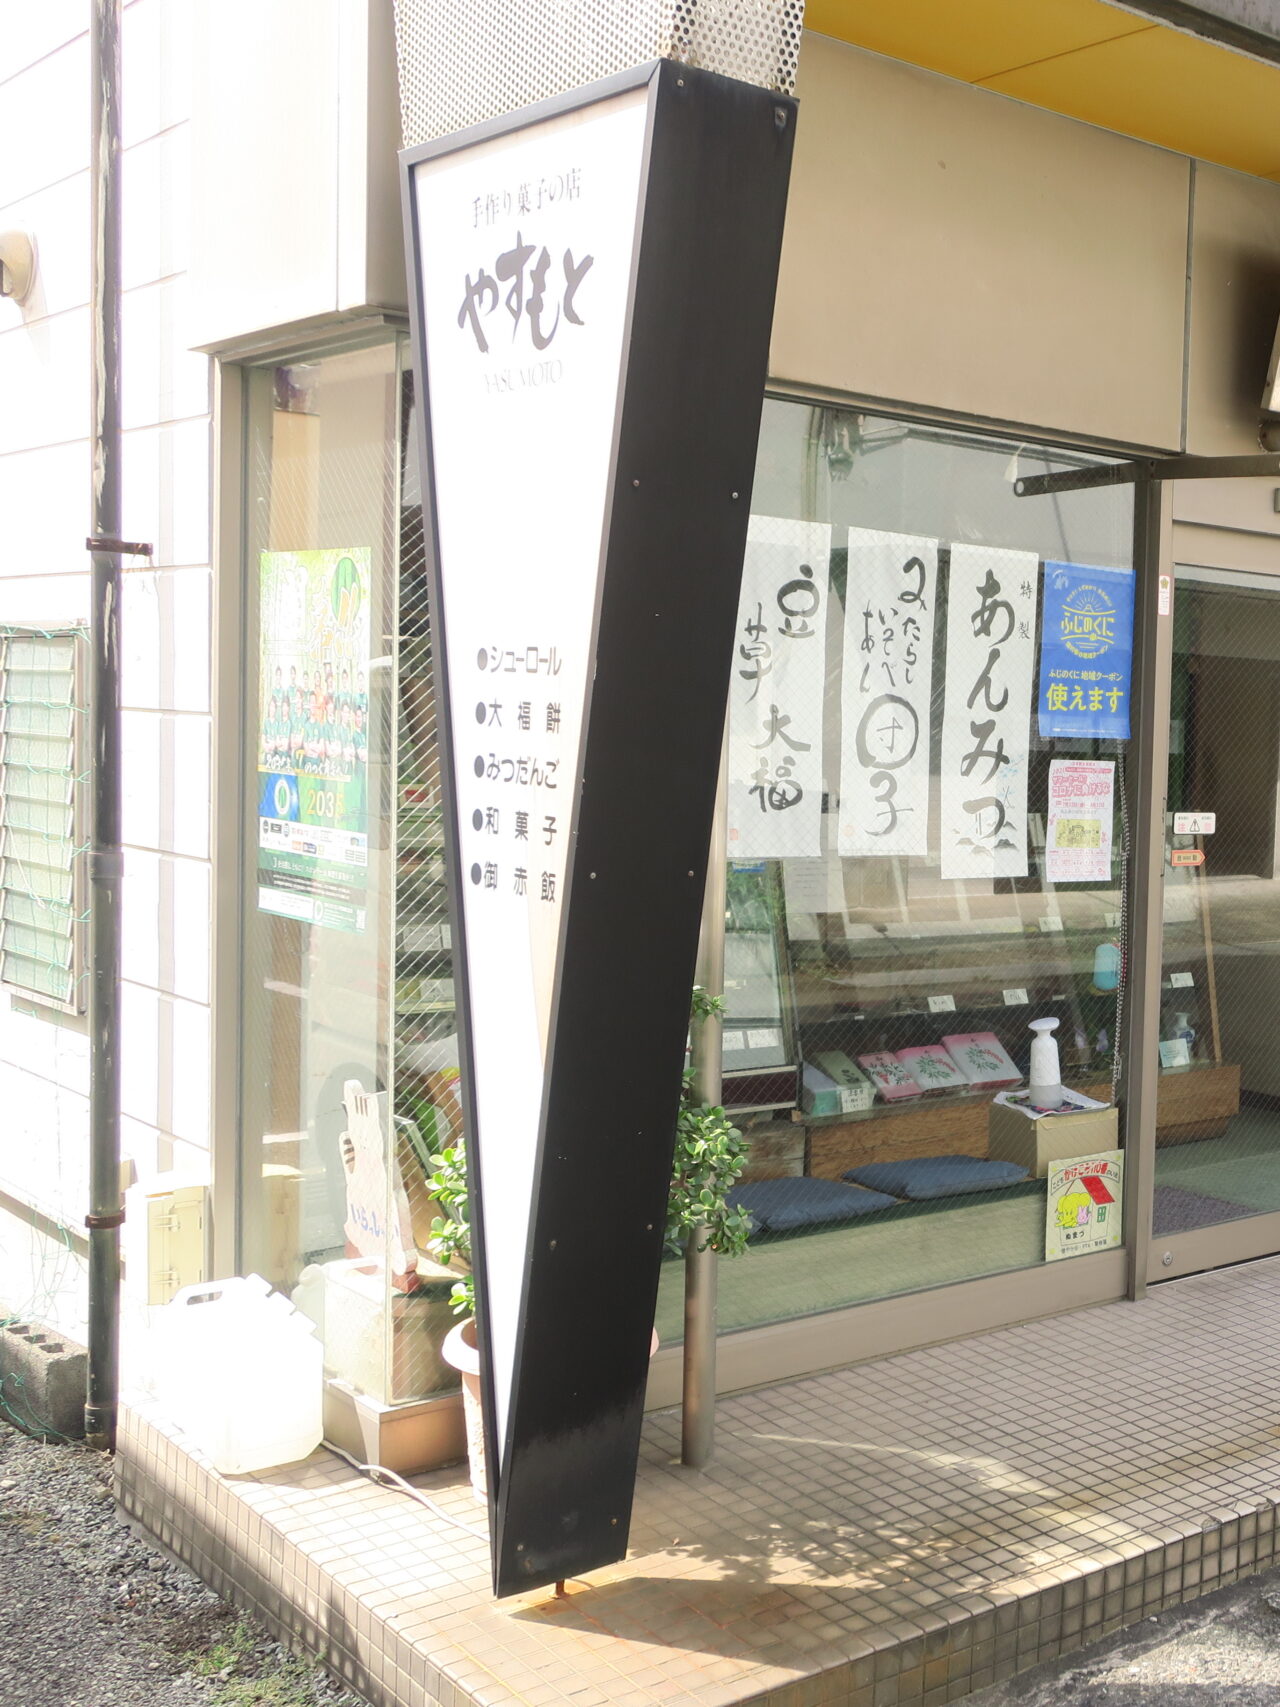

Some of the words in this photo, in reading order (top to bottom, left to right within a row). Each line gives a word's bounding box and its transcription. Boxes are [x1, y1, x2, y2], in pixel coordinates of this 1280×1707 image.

[472, 168, 581, 228] 手作り菓子の店
[457, 230, 594, 354] やすもと
[1018, 580, 1034, 641] 特製
[1060, 612, 1115, 637] ふじのくに
[490, 646, 562, 675] シューロール
[487, 698, 561, 734] 大福餅
[960, 569, 1015, 837] あんみつ
[1047, 683, 1124, 713] 使えます
[486, 753, 560, 789] みつだんご
[485, 806, 557, 846] 和菓子
[484, 861, 556, 904] 御赤飯
